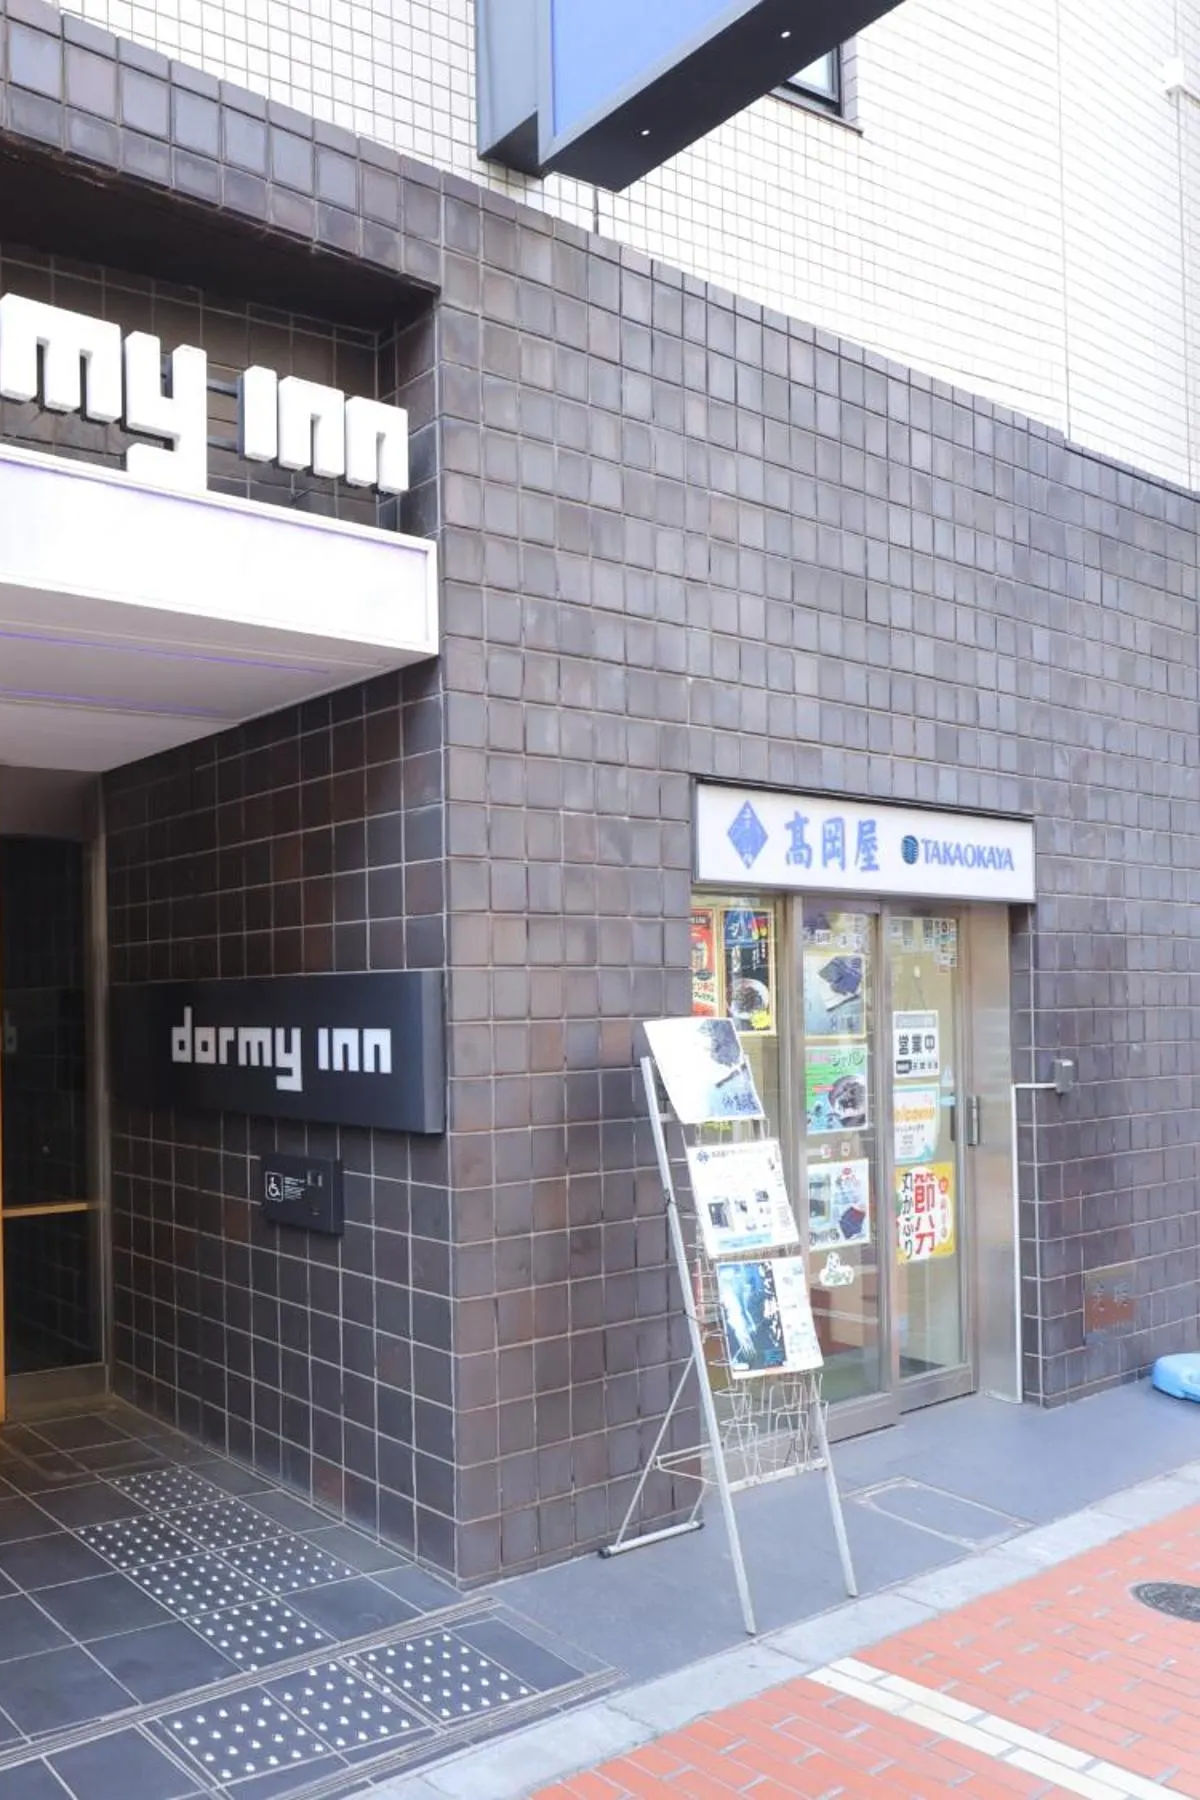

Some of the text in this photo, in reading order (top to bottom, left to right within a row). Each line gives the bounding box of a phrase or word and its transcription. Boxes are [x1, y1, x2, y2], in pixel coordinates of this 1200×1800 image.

[242, 365, 409, 494] inn
[920, 838, 1015, 871] TAKAOKAYA
[172, 1006, 392, 1092] dormy inn
[898, 1033, 936, 1056] 営業中
[902, 1172, 916, 1260] 丸かぶり
[914, 1171, 936, 1256] 節分
